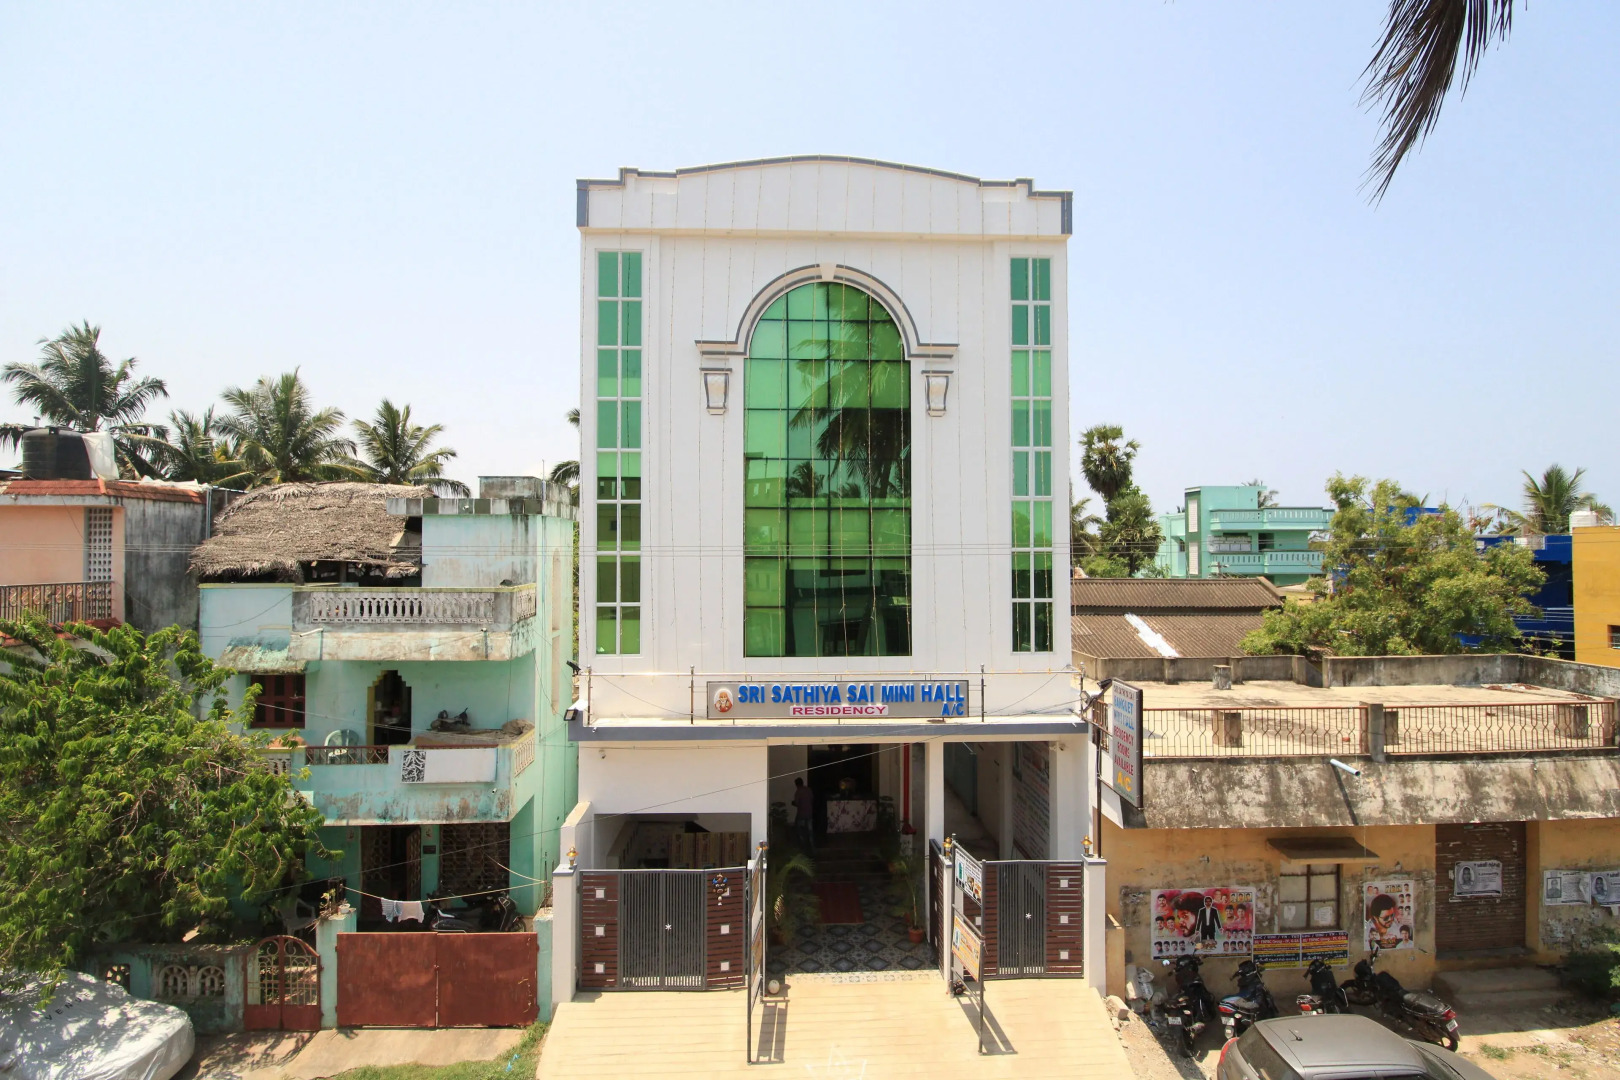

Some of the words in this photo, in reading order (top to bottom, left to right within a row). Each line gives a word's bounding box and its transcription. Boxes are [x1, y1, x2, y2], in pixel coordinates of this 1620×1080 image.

[737, 685, 765, 704] SRI
[771, 685, 841, 704] SATHIYA
[846, 685, 874, 703] SAI
[881, 684, 915, 703] MINI
[921, 684, 964, 703] HALL
[792, 706, 886, 715] RESIDENCY
[941, 703, 964, 716] A/C
